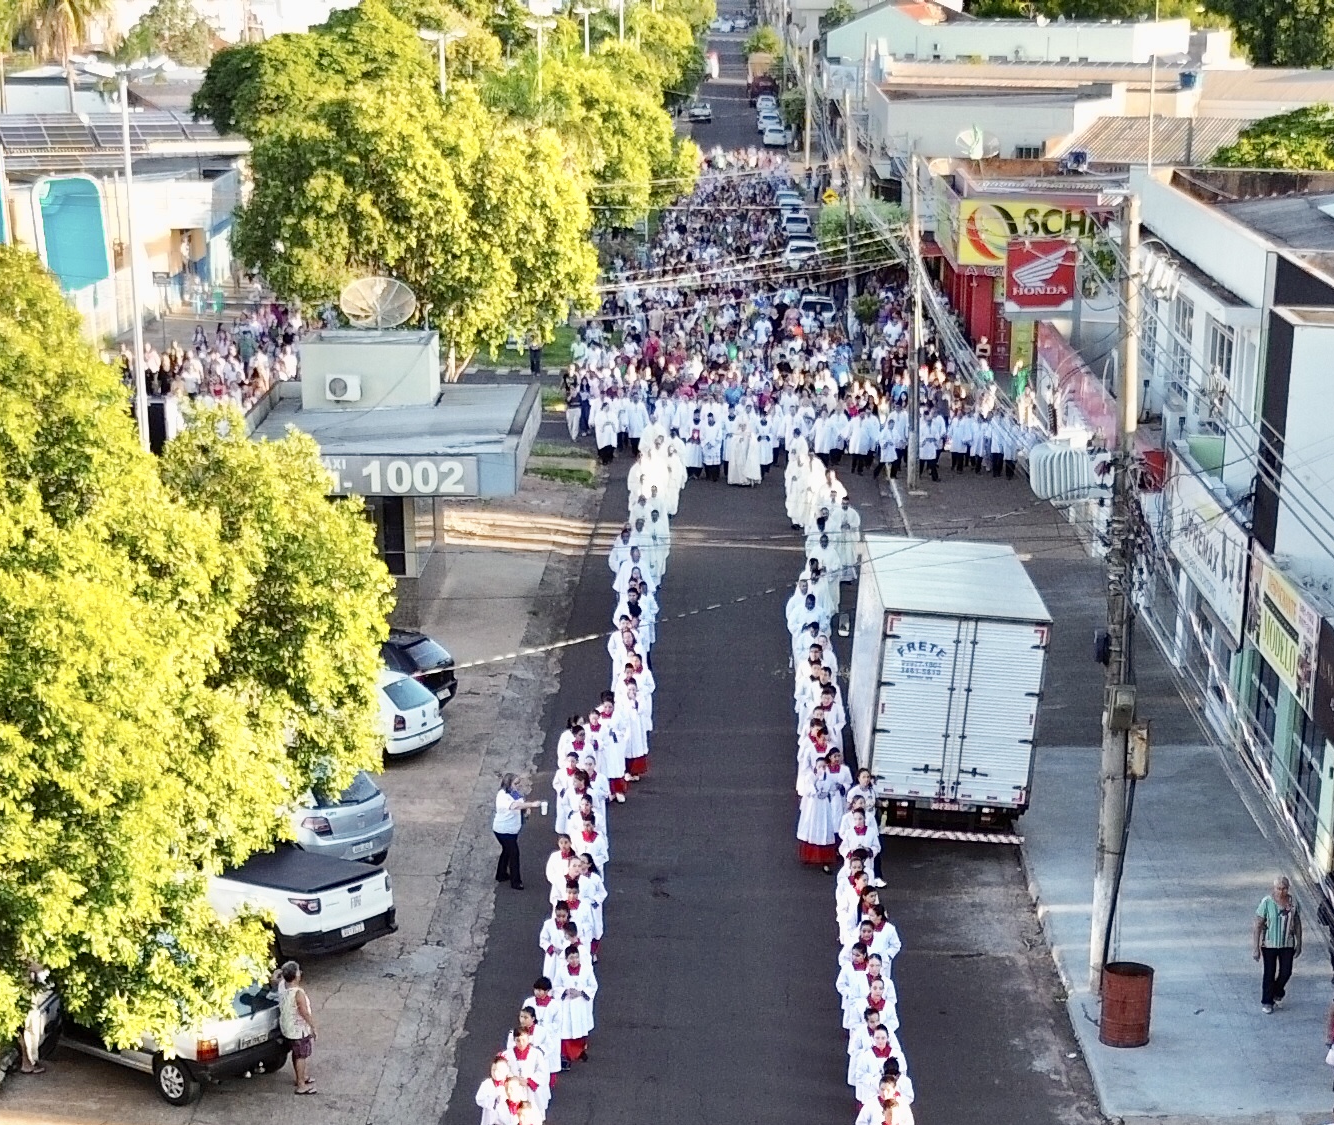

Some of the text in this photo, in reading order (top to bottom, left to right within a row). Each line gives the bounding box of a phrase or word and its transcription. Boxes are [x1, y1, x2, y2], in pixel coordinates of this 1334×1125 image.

[1011, 285, 1068, 297] HONDA
[322, 459, 347, 470] AXI
[362, 460, 465, 494] 1002
[896, 640, 947, 661] FRETE
